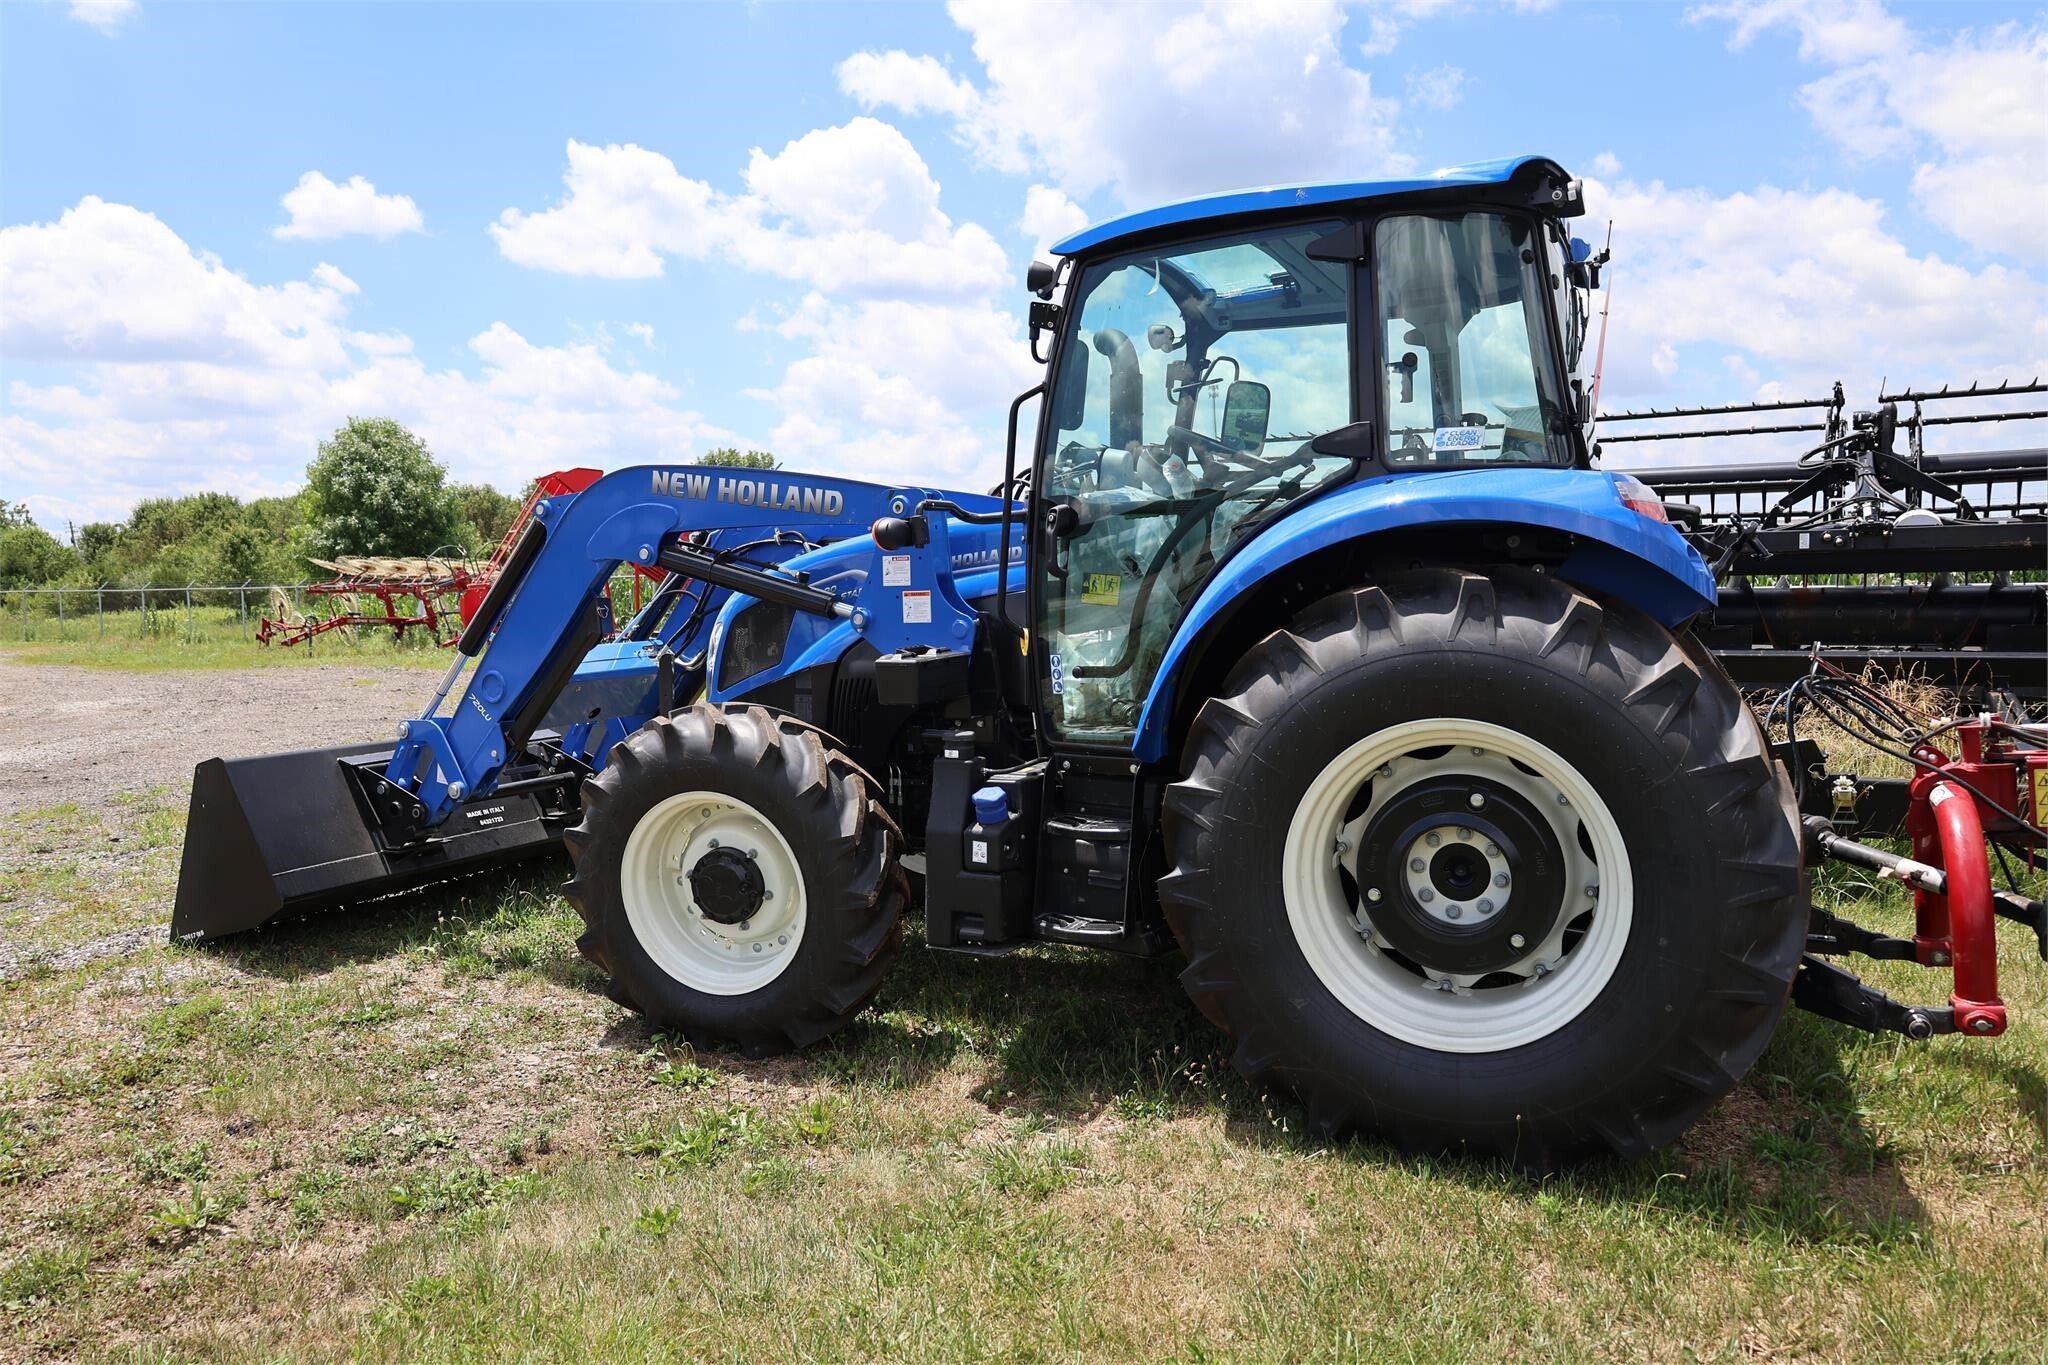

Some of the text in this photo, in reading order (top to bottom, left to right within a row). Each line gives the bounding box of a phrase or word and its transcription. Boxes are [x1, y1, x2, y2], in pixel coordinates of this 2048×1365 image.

[652, 470, 844, 516] NEW HOLLAND
[952, 546, 1023, 567] HOLLAD
[468, 693, 491, 721] 720LU
[466, 810, 483, 818] MADE
[489, 806, 504, 814] ITALY
